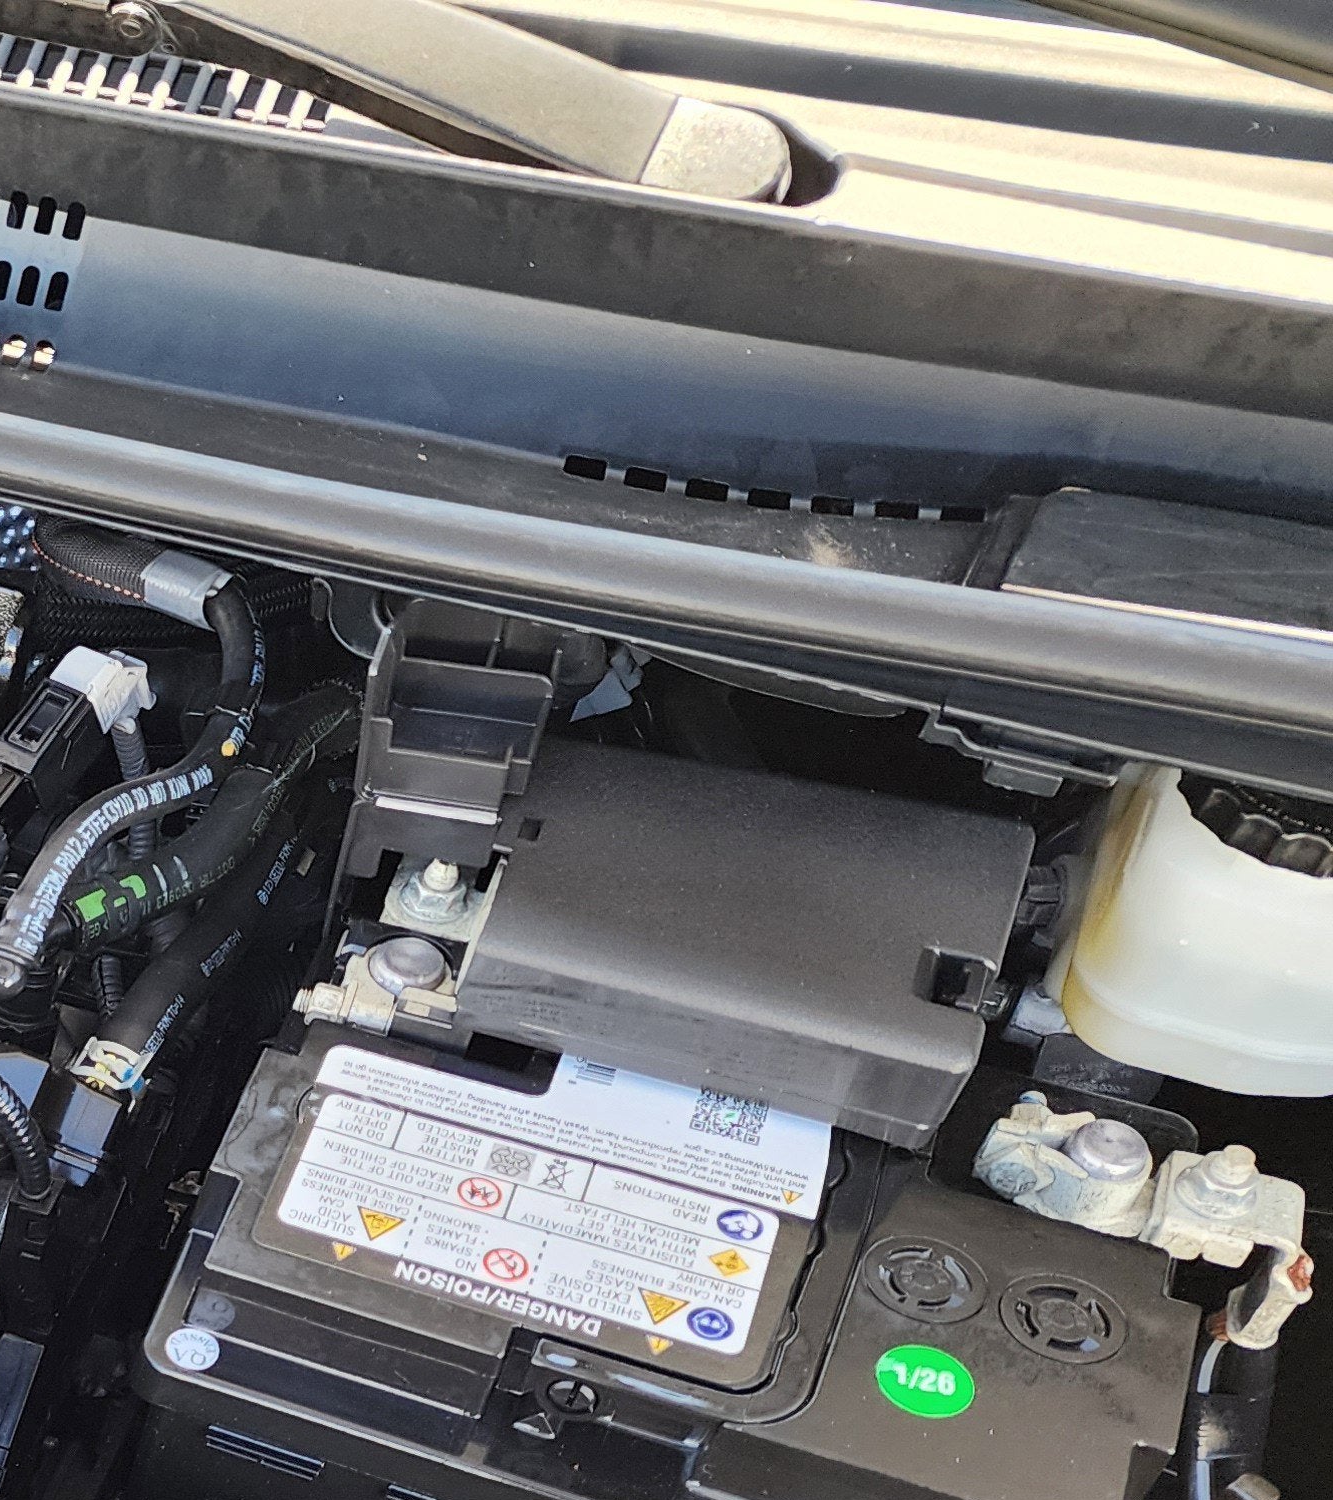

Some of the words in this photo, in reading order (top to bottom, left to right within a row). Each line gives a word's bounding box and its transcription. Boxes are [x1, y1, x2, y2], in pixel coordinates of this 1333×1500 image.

[335, 1118, 363, 1134] NOT
[353, 1113, 388, 1130] OPEN
[366, 1128, 384, 1140] DO
[422, 1133, 436, 1144] BE
[417, 1143, 474, 1167] BATTERY
[441, 1139, 478, 1157] MUST
[339, 1155, 364, 1169] THE
[365, 1163, 382, 1174] OF
[389, 1158, 406, 1170] OF
[384, 1168, 413, 1184] OUT
[409, 1164, 453, 1184] REACH
[301, 1177, 367, 1203] BLINDNESS
[349, 1179, 395, 1200] SEVERE
[416, 1177, 450, 1194] KEEP
[318, 1193, 345, 1208] CAN
[371, 1197, 410, 1215] CAUSE
[396, 1193, 414, 1206] OR
[287, 1208, 355, 1236] SULFURIC
[317, 1204, 351, 1223] ACID
[422, 1209, 482, 1234] SMOKING
[600, 1210, 636, 1229] HELP
[671, 1206, 708, 1224] READ
[520, 1210, 610, 1244] IMMEDIATELY
[578, 1216, 605, 1231] GET
[426, 1223, 477, 1245] FLAMES
[640, 1222, 701, 1248] MEDICAL
[423, 1235, 473, 1256] SPARKS
[612, 1237, 646, 1254] EYES
[660, 1240, 697, 1258] WITH
[453, 1257, 477, 1272] NO
[649, 1247, 694, 1269] FLUSH
[584, 1268, 635, 1292] GASES
[590, 1258, 664, 1287] BLINDNESS
[548, 1271, 631, 1304] EXPLOSIVE
[667, 1280, 710, 1300] CAUSE
[725, 1284, 745, 1297] OR
[392, 1259, 602, 1337] DANGER/POISON
[713, 1293, 742, 1309] CAN
[586, 1295, 643, 1321] SHIELD
[889, 1360, 957, 1397] 1/26
